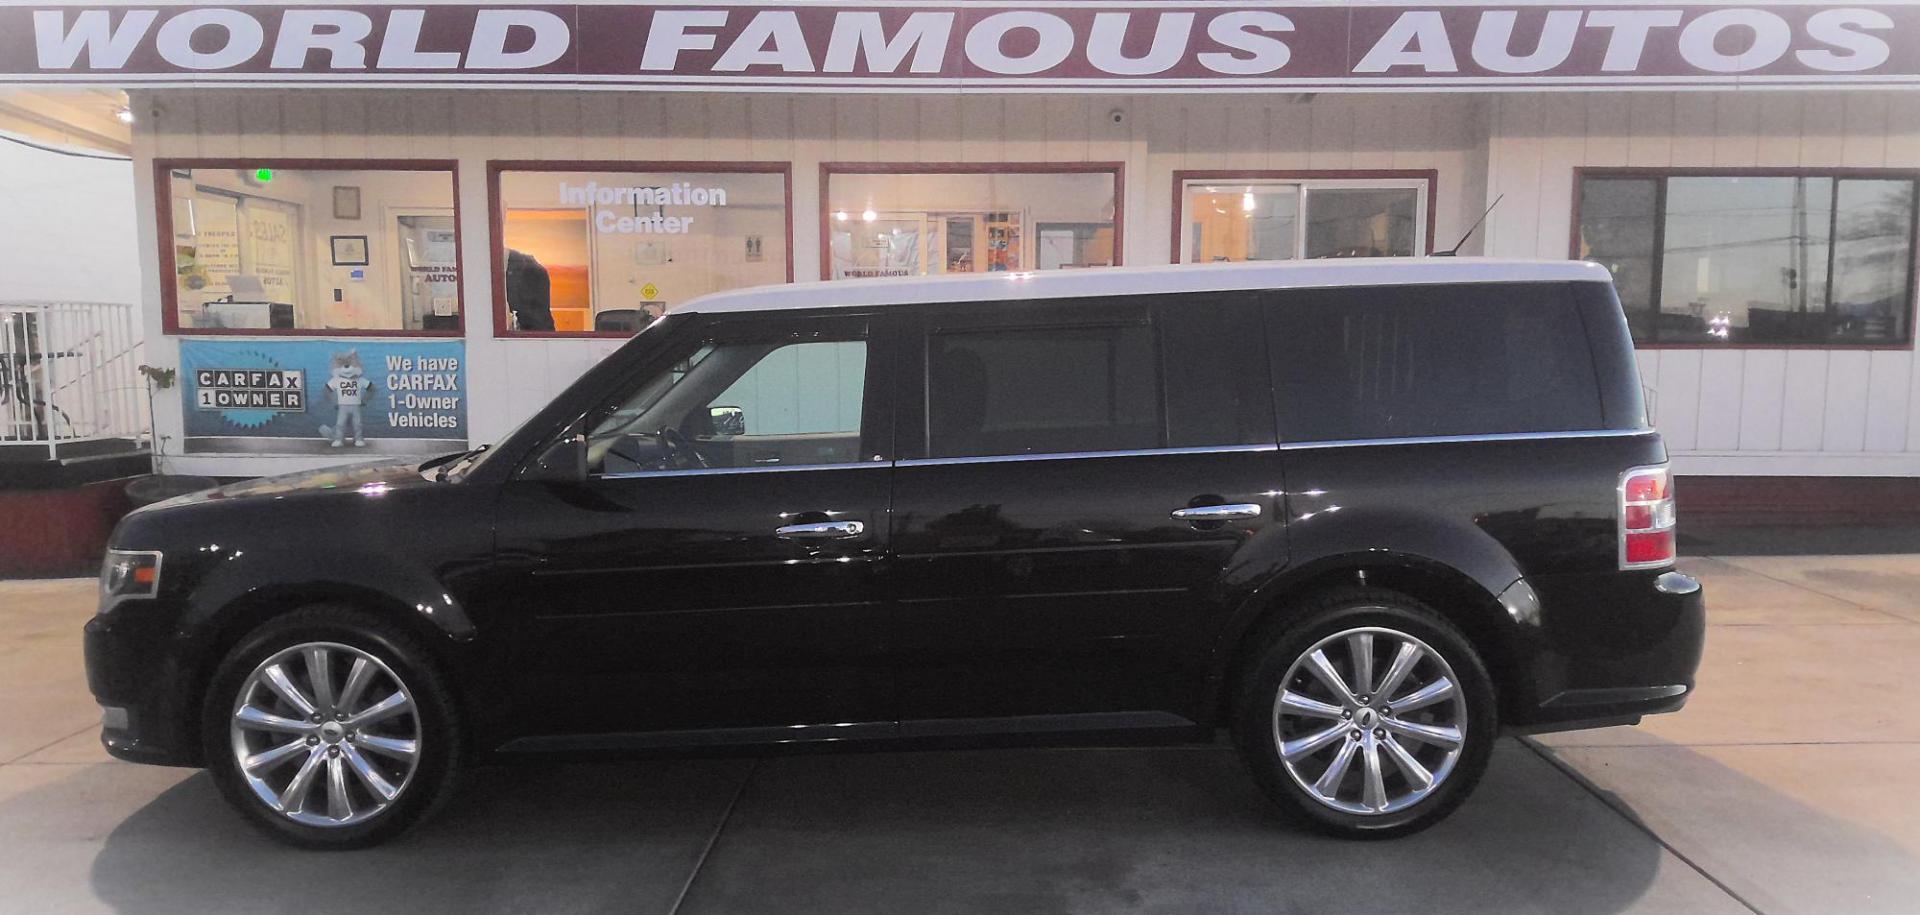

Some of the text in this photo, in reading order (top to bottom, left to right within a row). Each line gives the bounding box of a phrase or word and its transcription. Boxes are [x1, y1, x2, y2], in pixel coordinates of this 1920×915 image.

[33, 7, 1895, 76] WORLD FAMOUS AUTOS
[559, 182, 727, 207] Information
[595, 209, 694, 234] Center
[844, 269, 909, 278] WORLD FAMOUS
[386, 355, 458, 371] We have
[199, 371, 299, 389] CARFAX
[340, 381, 358, 389] CAR
[387, 374, 457, 391] CARFAX
[218, 391, 299, 406] OWNER
[341, 389, 358, 397] FOX
[389, 395, 459, 410] 1-Owner
[388, 411, 458, 428] Vehicles
